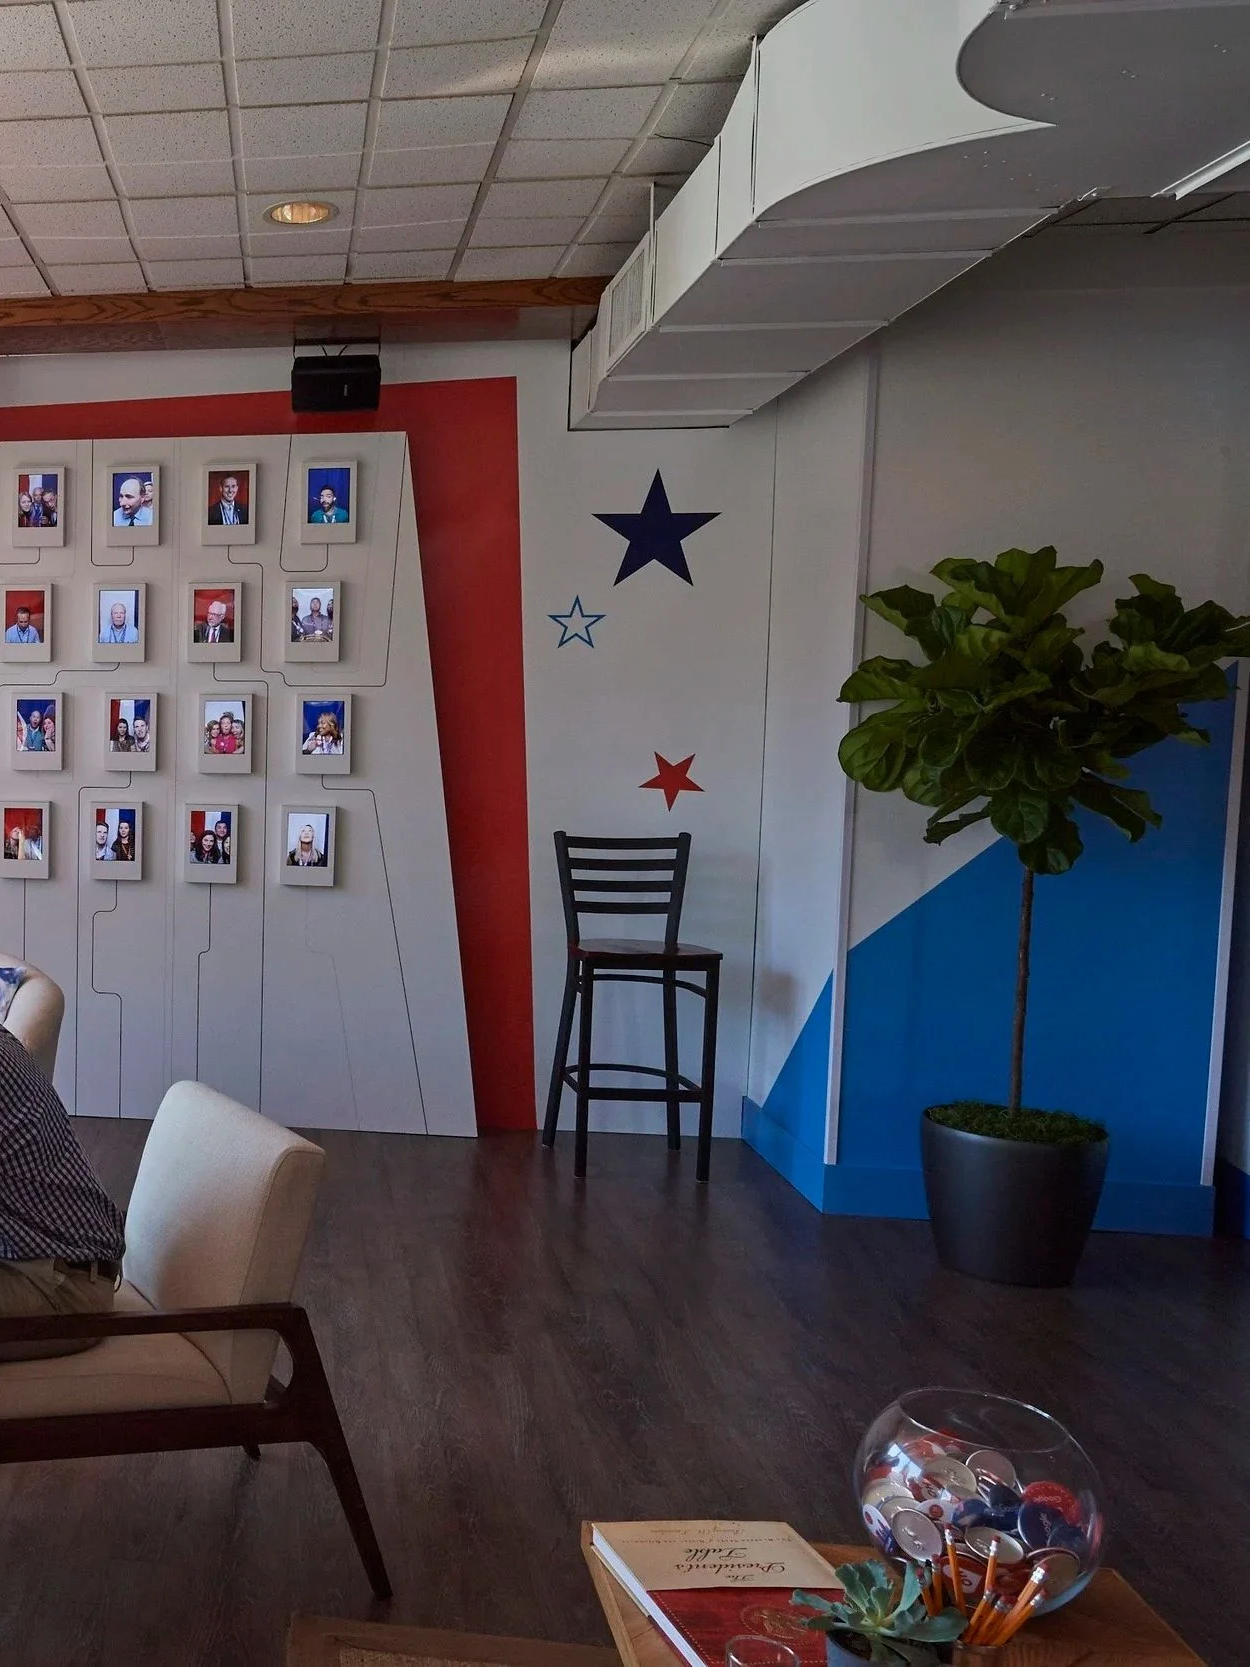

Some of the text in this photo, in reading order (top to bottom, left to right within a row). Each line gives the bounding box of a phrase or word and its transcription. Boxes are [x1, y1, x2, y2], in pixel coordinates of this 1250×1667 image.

[1032, 1495, 1062, 1504] Google
[686, 1547, 748, 1562] Table
[674, 1562, 786, 1575] President's
[726, 1574, 757, 1583] The
